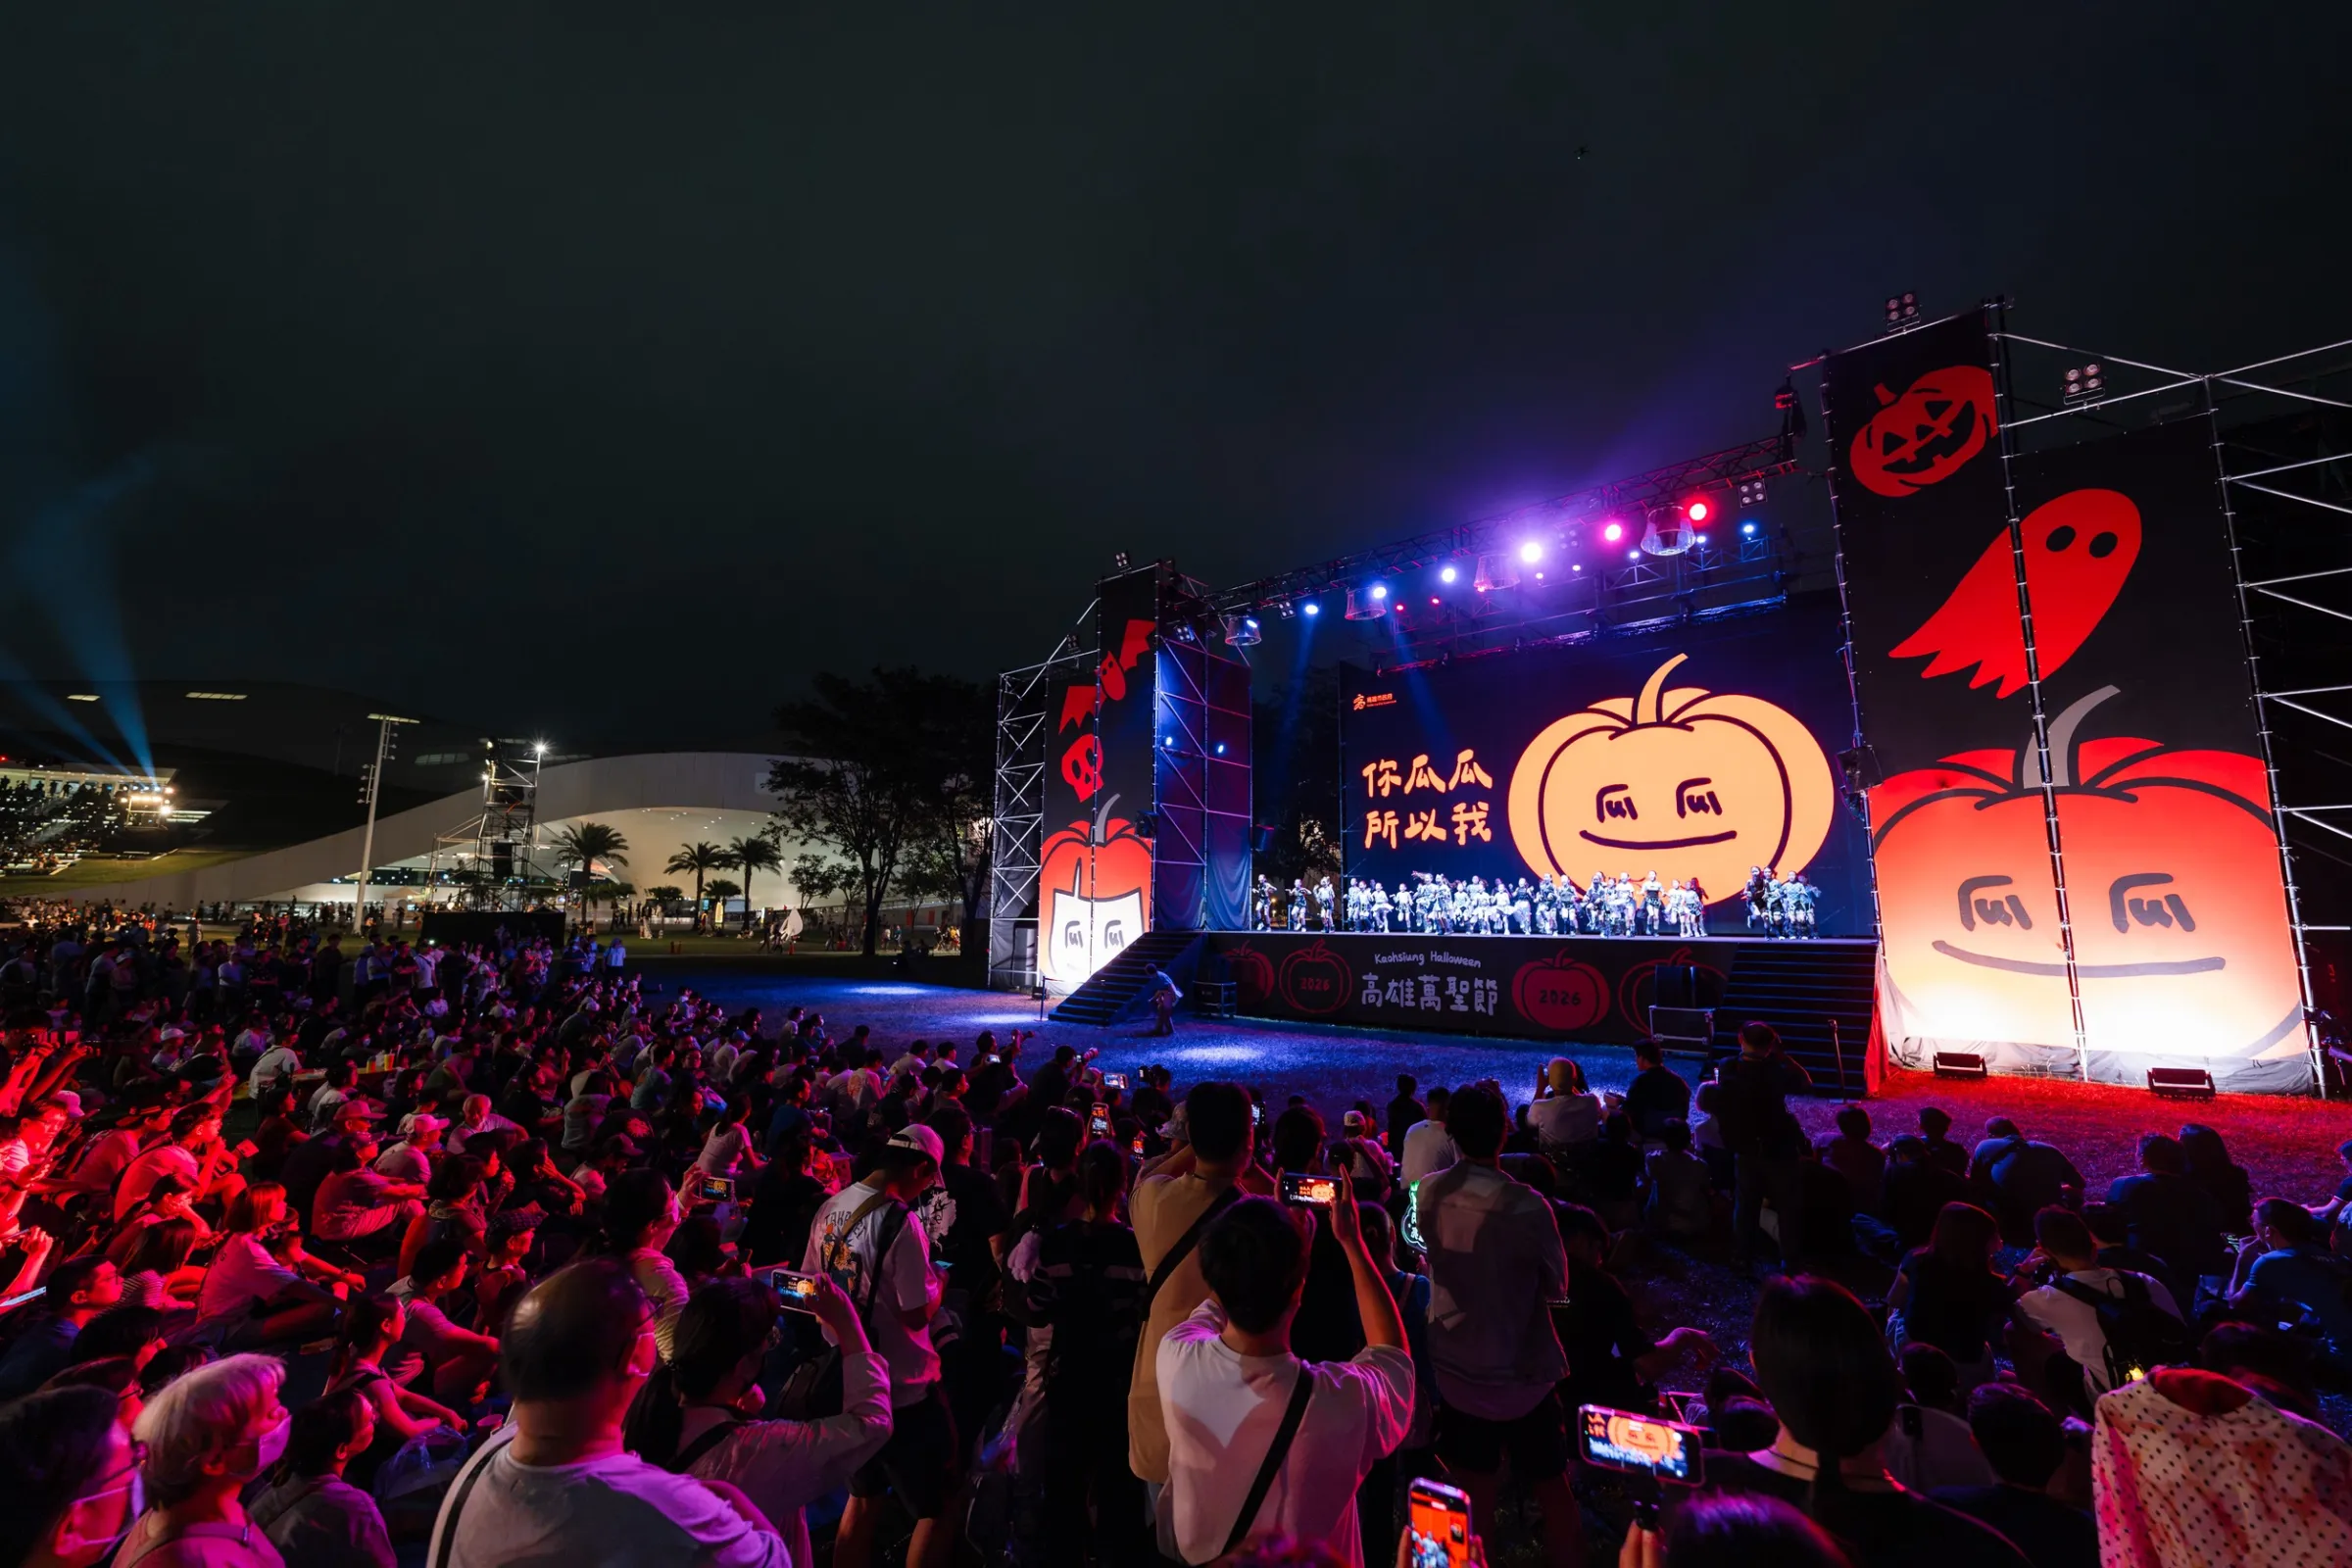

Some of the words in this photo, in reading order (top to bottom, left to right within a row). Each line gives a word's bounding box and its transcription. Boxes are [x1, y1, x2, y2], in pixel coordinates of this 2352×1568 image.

[1362, 749, 1493, 798] 你瓜瓜
[1364, 802, 1492, 849] 所以我
[1374, 952, 1424, 966] Kaohsiung
[1430, 951, 1481, 968] Halloween
[1299, 977, 1330, 991] 2026
[1361, 972, 1497, 1015] 高雄萬聖節
[1539, 989, 1581, 1006] 2026
